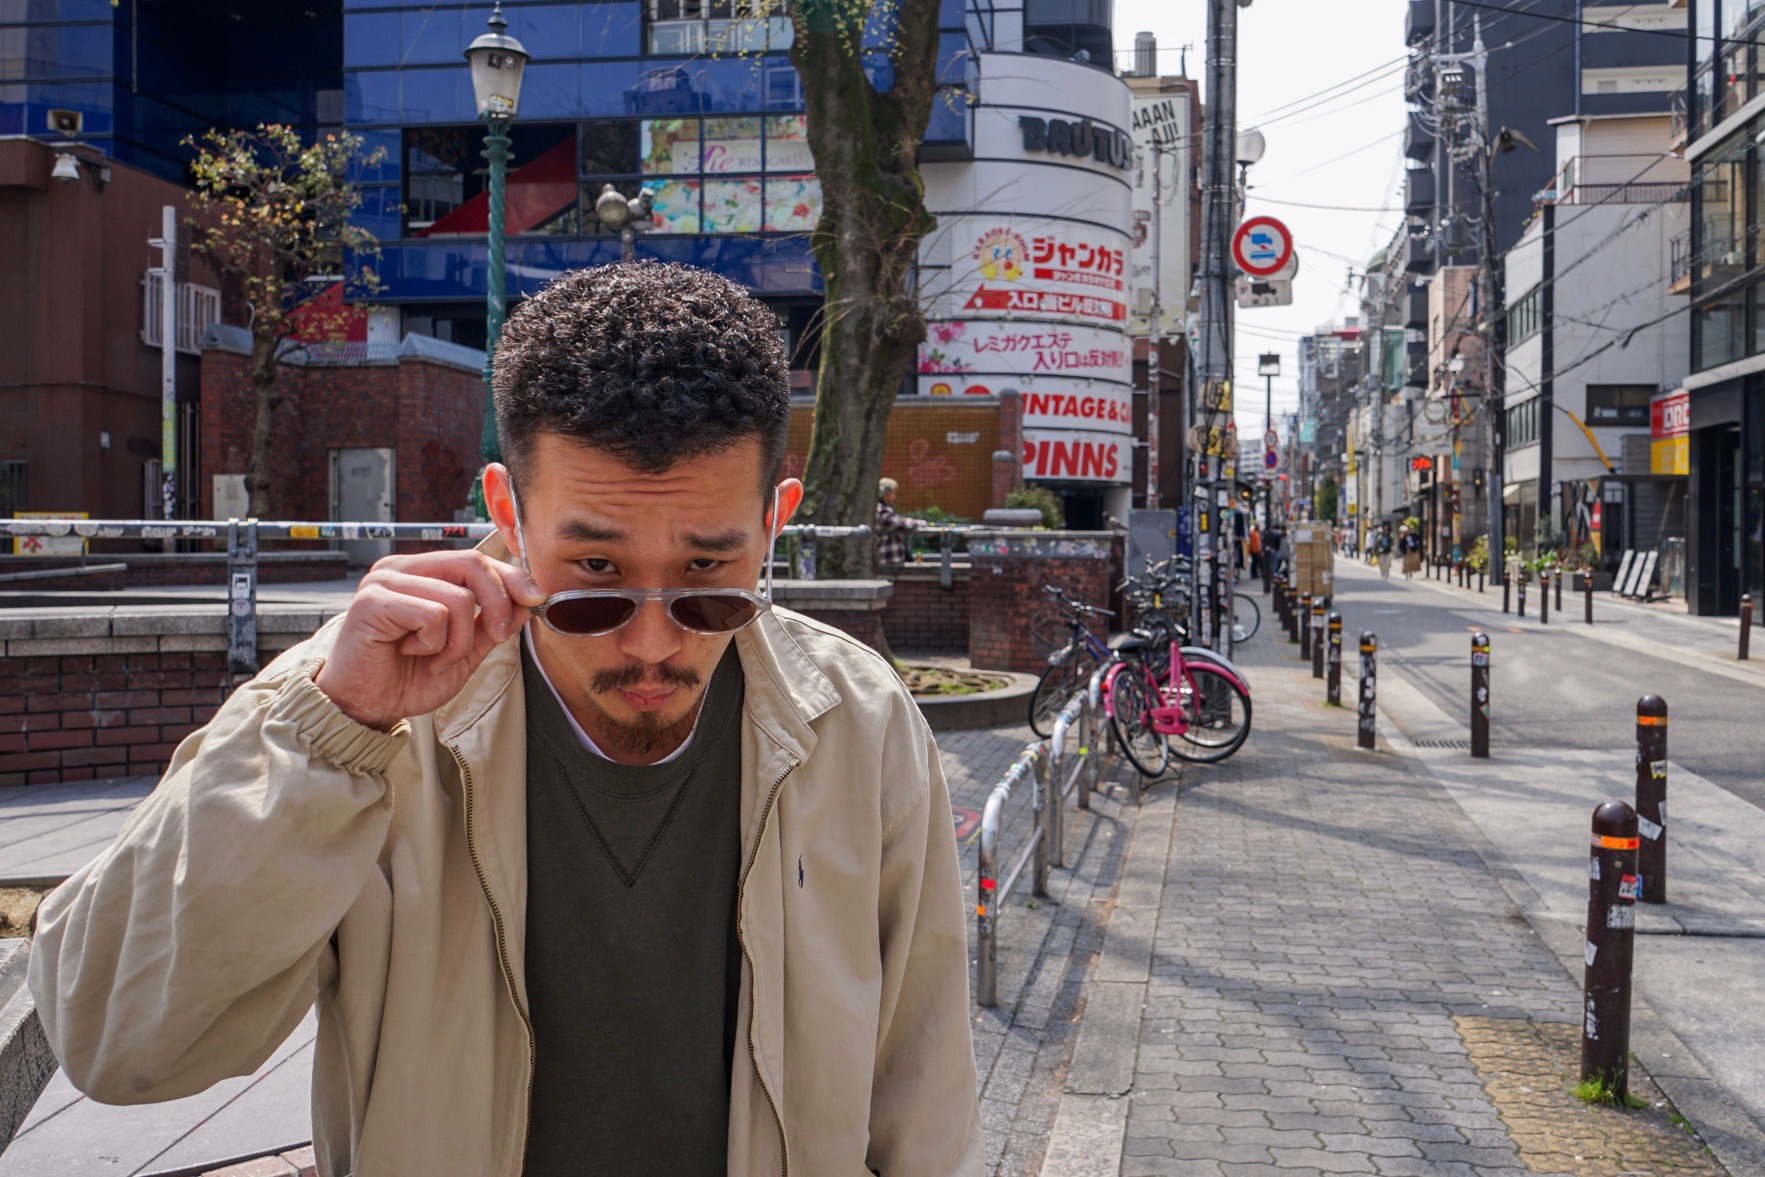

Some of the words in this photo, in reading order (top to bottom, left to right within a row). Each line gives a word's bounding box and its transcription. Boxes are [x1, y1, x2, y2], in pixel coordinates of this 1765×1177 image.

[1018, 116, 1133, 170] BRUTUS
[1033, 235, 1124, 276] ジャンカラ
[973, 331, 1072, 353] レミガクエステ
[1023, 441, 1118, 479] PINNS
